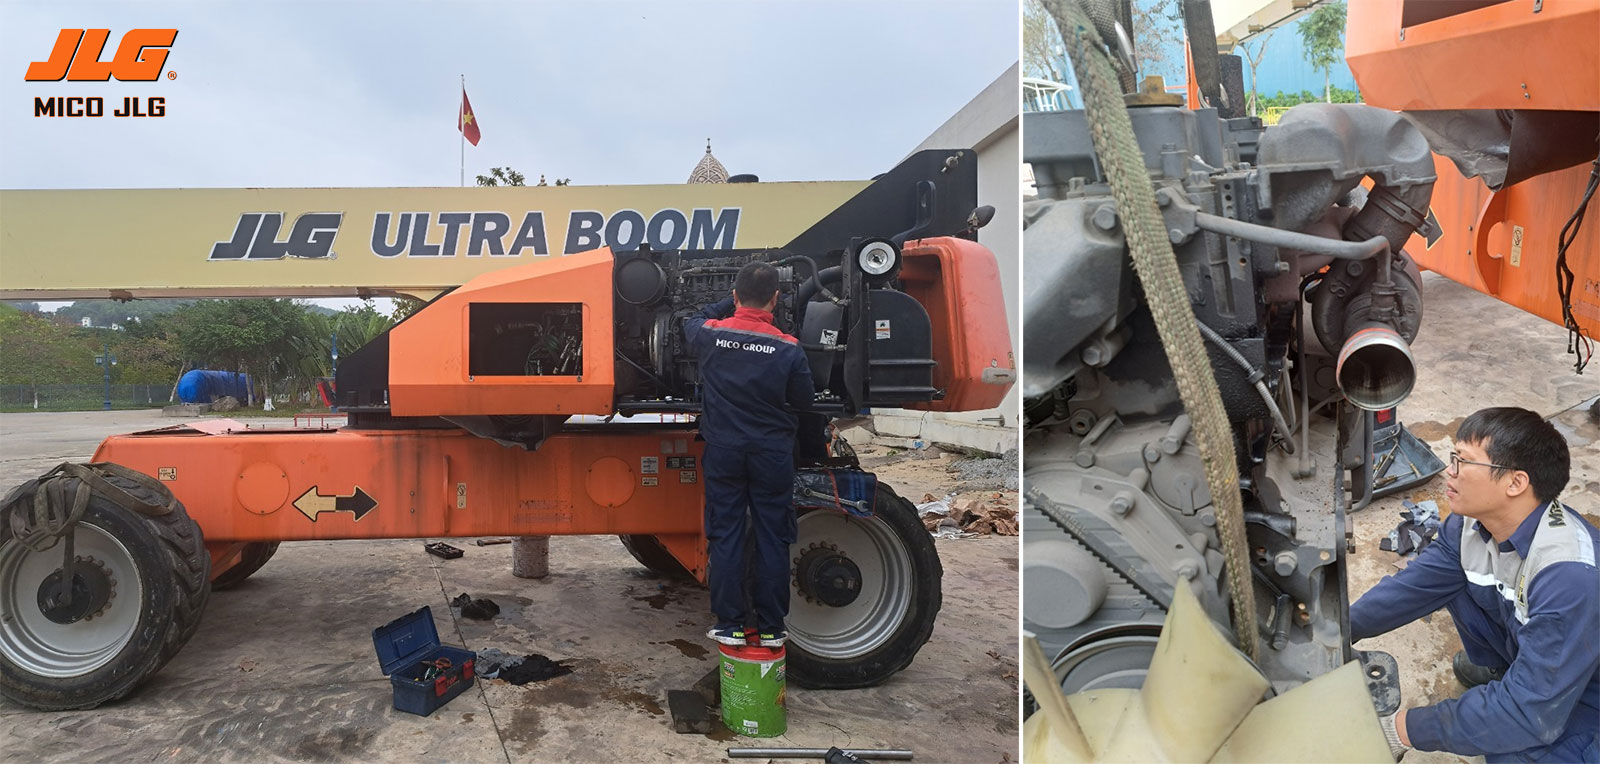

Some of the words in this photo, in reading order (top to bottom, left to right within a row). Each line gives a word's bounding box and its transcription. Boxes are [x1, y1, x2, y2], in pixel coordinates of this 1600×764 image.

[207, 212, 344, 261] JLG
[370, 211, 550, 259] ULTRA
[562, 207, 742, 256] BOOM
[715, 338, 741, 349] MICO
[742, 343, 776, 354] GROUP
